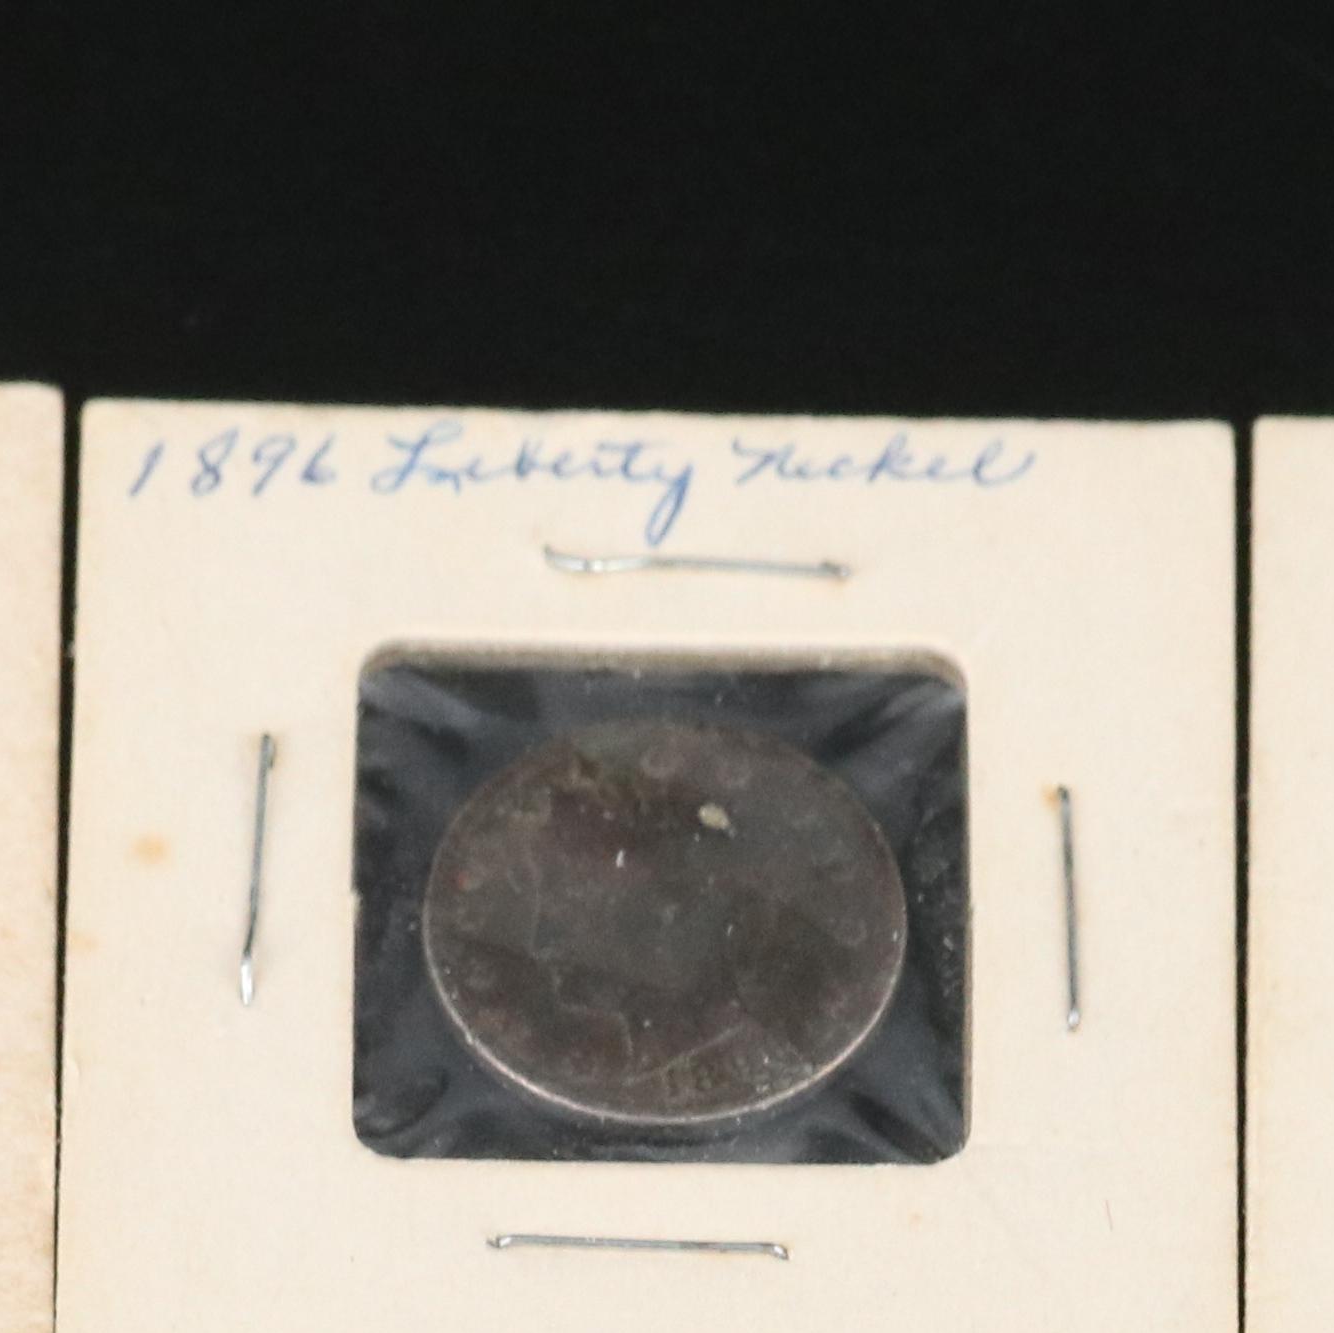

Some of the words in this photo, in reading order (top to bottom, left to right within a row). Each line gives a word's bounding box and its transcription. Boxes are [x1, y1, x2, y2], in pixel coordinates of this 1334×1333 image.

[129, 427, 337, 497] 1896
[370, 419, 694, 548] Liberty
[731, 431, 1035, 487] Nickel
